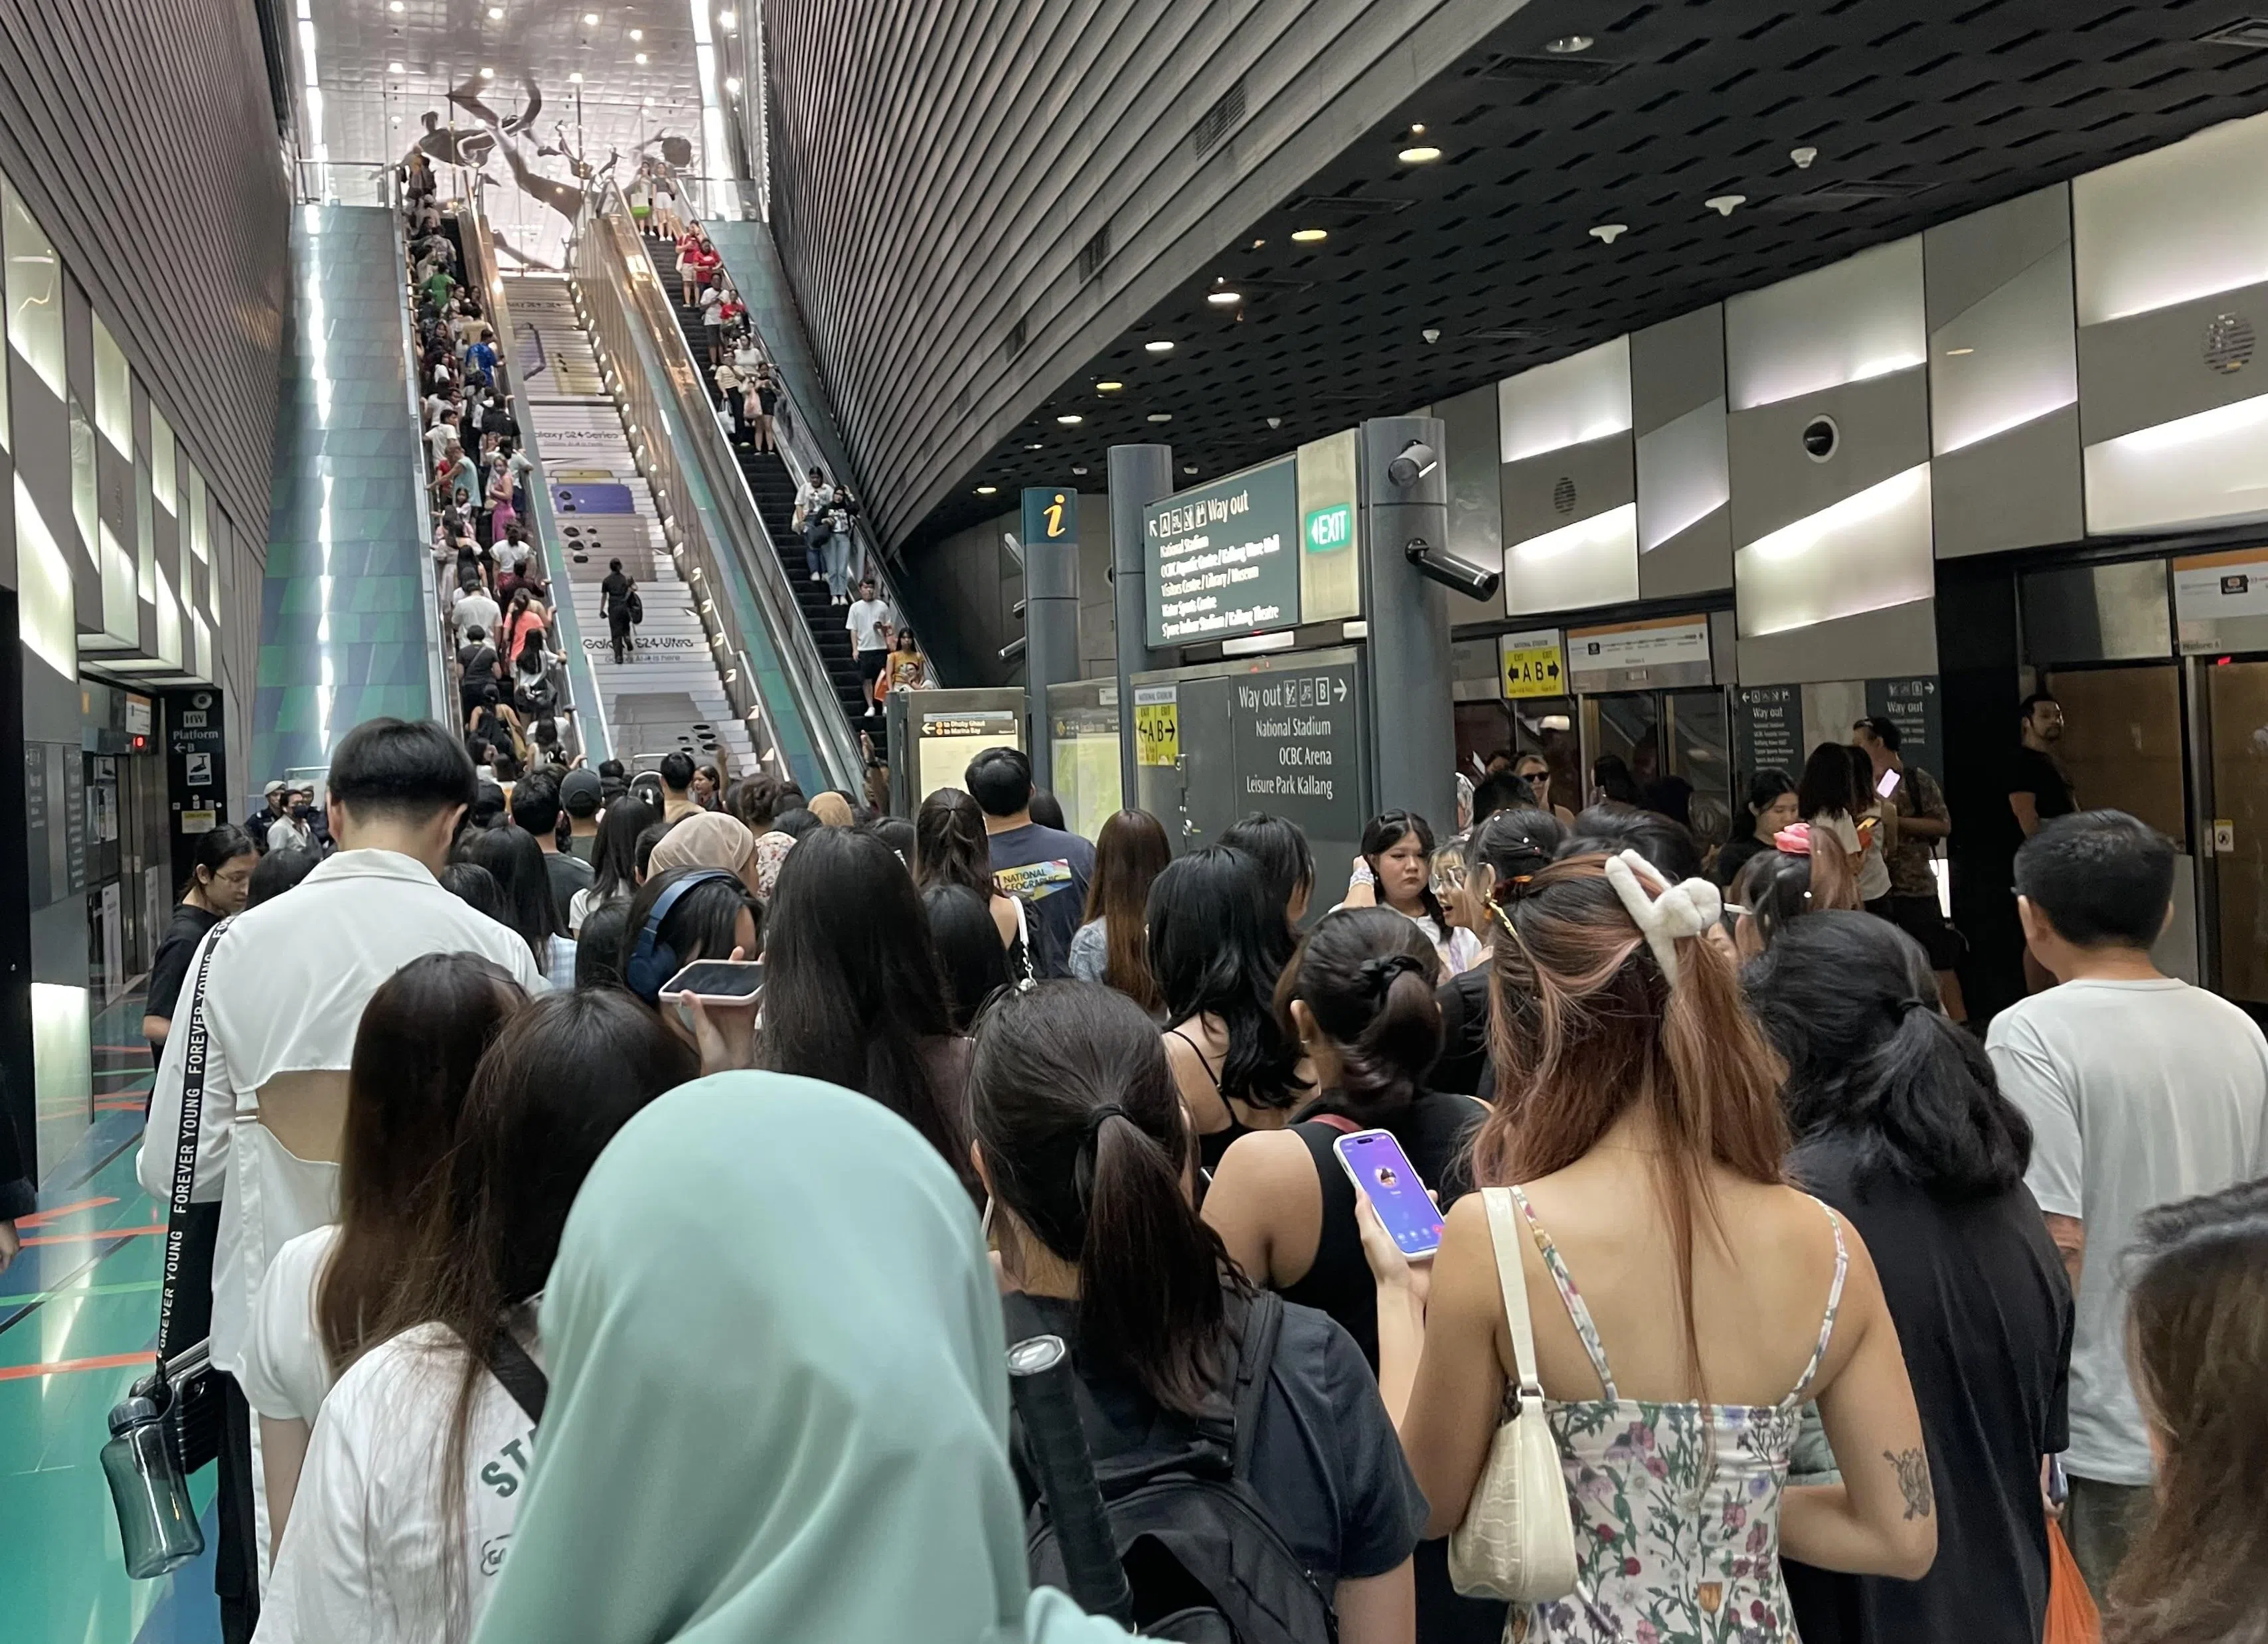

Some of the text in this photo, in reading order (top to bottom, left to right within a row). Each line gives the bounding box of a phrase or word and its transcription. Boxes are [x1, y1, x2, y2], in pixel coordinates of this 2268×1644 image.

[1043, 494, 1066, 537] i
[1208, 499, 1228, 523] Way
[1230, 489, 1250, 515] out
[1319, 510, 1346, 544] EXIT
[635, 638, 659, 649] S24
[659, 637, 693, 649] Ultra
[1522, 661, 1544, 683] A B
[1238, 683, 1327, 712] Way out B
[1886, 700, 1923, 716] Way out
[1141, 707, 1150, 718] EXIT
[1161, 705, 1171, 716] EXIT
[1753, 706, 1783, 720] Way out
[173, 730, 219, 740] Platform
[1148, 720, 1164, 742] A B
[1256, 716, 1331, 737] National Stadium
[188, 743, 195, 752] B
[1279, 747, 1332, 766] OCBC Arena
[1246, 774, 1333, 799] Leisure Park Kallang
[1003, 868, 1047, 884] NATIONAL
[173, 1088, 201, 1214] FOREVER YOUNG
[165, 1230, 183, 1281] YOUNG
